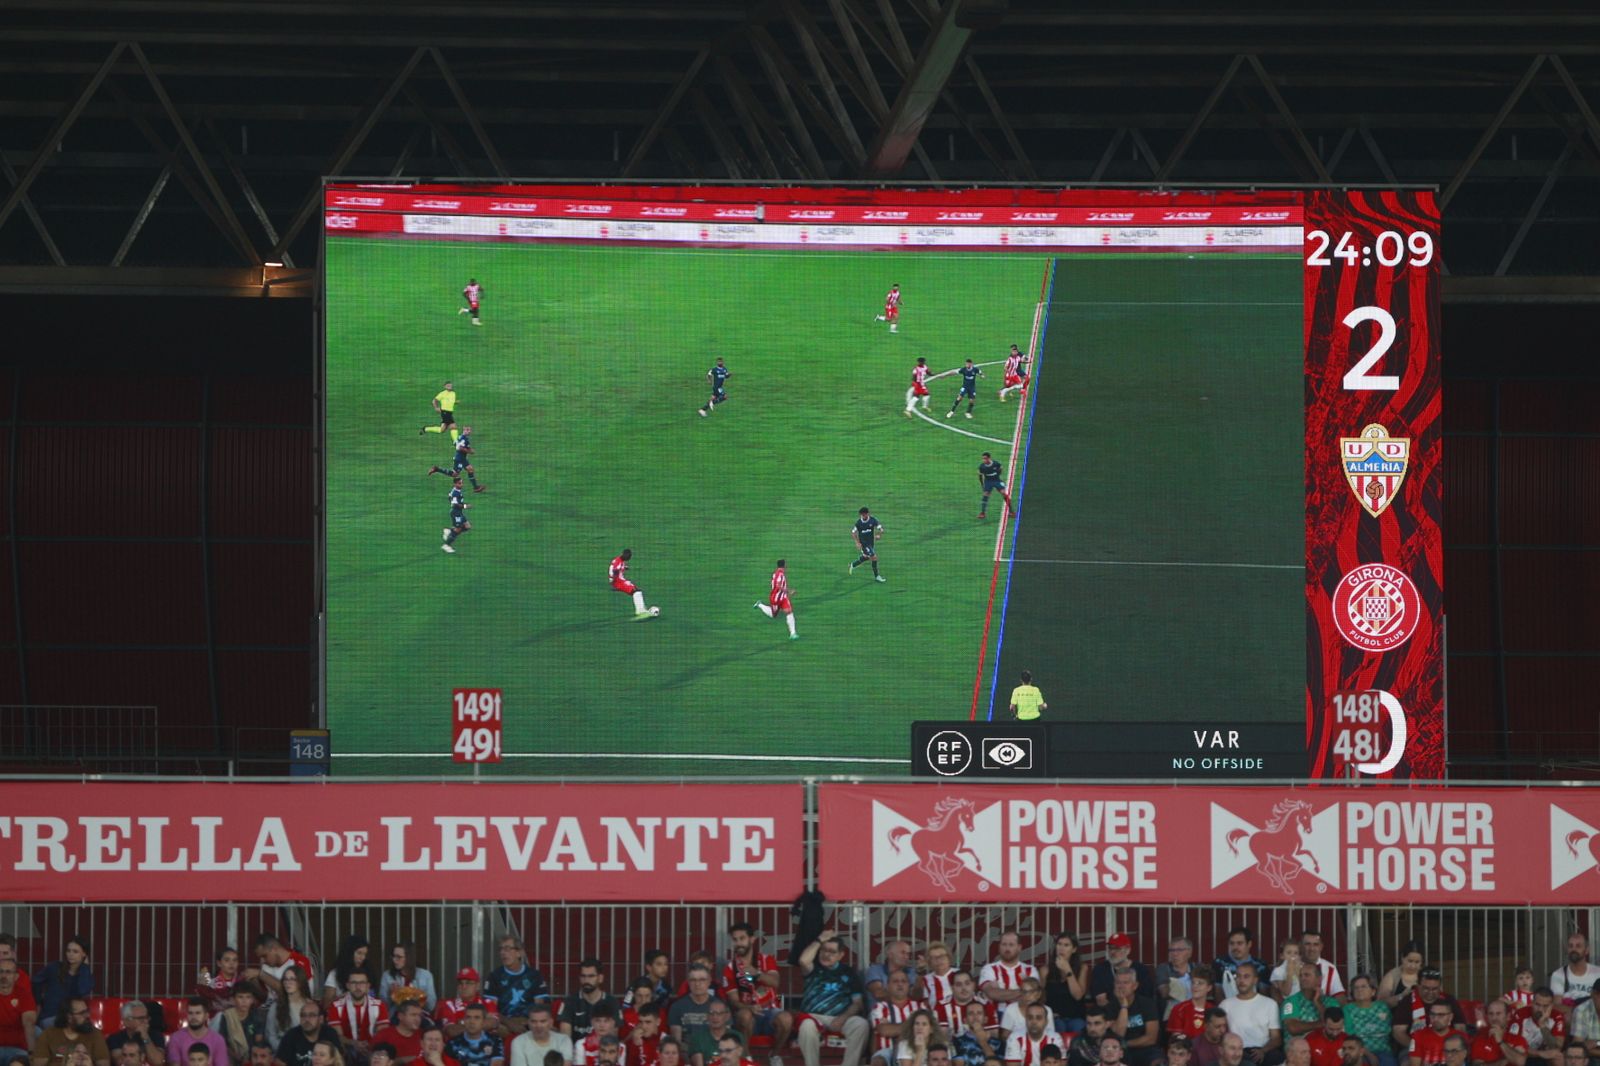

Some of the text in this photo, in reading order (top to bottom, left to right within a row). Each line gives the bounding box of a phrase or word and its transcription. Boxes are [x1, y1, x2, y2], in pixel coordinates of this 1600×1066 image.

[1306, 230, 1434, 267] 24:09
[1342, 305, 1400, 390] 2
[1349, 462, 1401, 472] ALMERIA
[1347, 567, 1405, 589] GIRONA
[1348, 629, 1405, 646] FUTBOL CLUB
[453, 692, 494, 722] 149
[1333, 693, 1373, 724] 148
[293, 744, 325, 759] 148
[454, 728, 494, 761] 49
[1193, 730, 1240, 749] VAR
[1333, 728, 1373, 762] 48
[1172, 758, 1264, 769] NO OFFSIDE
[1008, 800, 1157, 844] POWER
[1347, 801, 1495, 846] POWER
[314, 830, 370, 858] DE
[380, 816, 775, 873] LEVANTE
[1008, 845, 1158, 890] HORSE
[1347, 847, 1496, 892] HORSE
